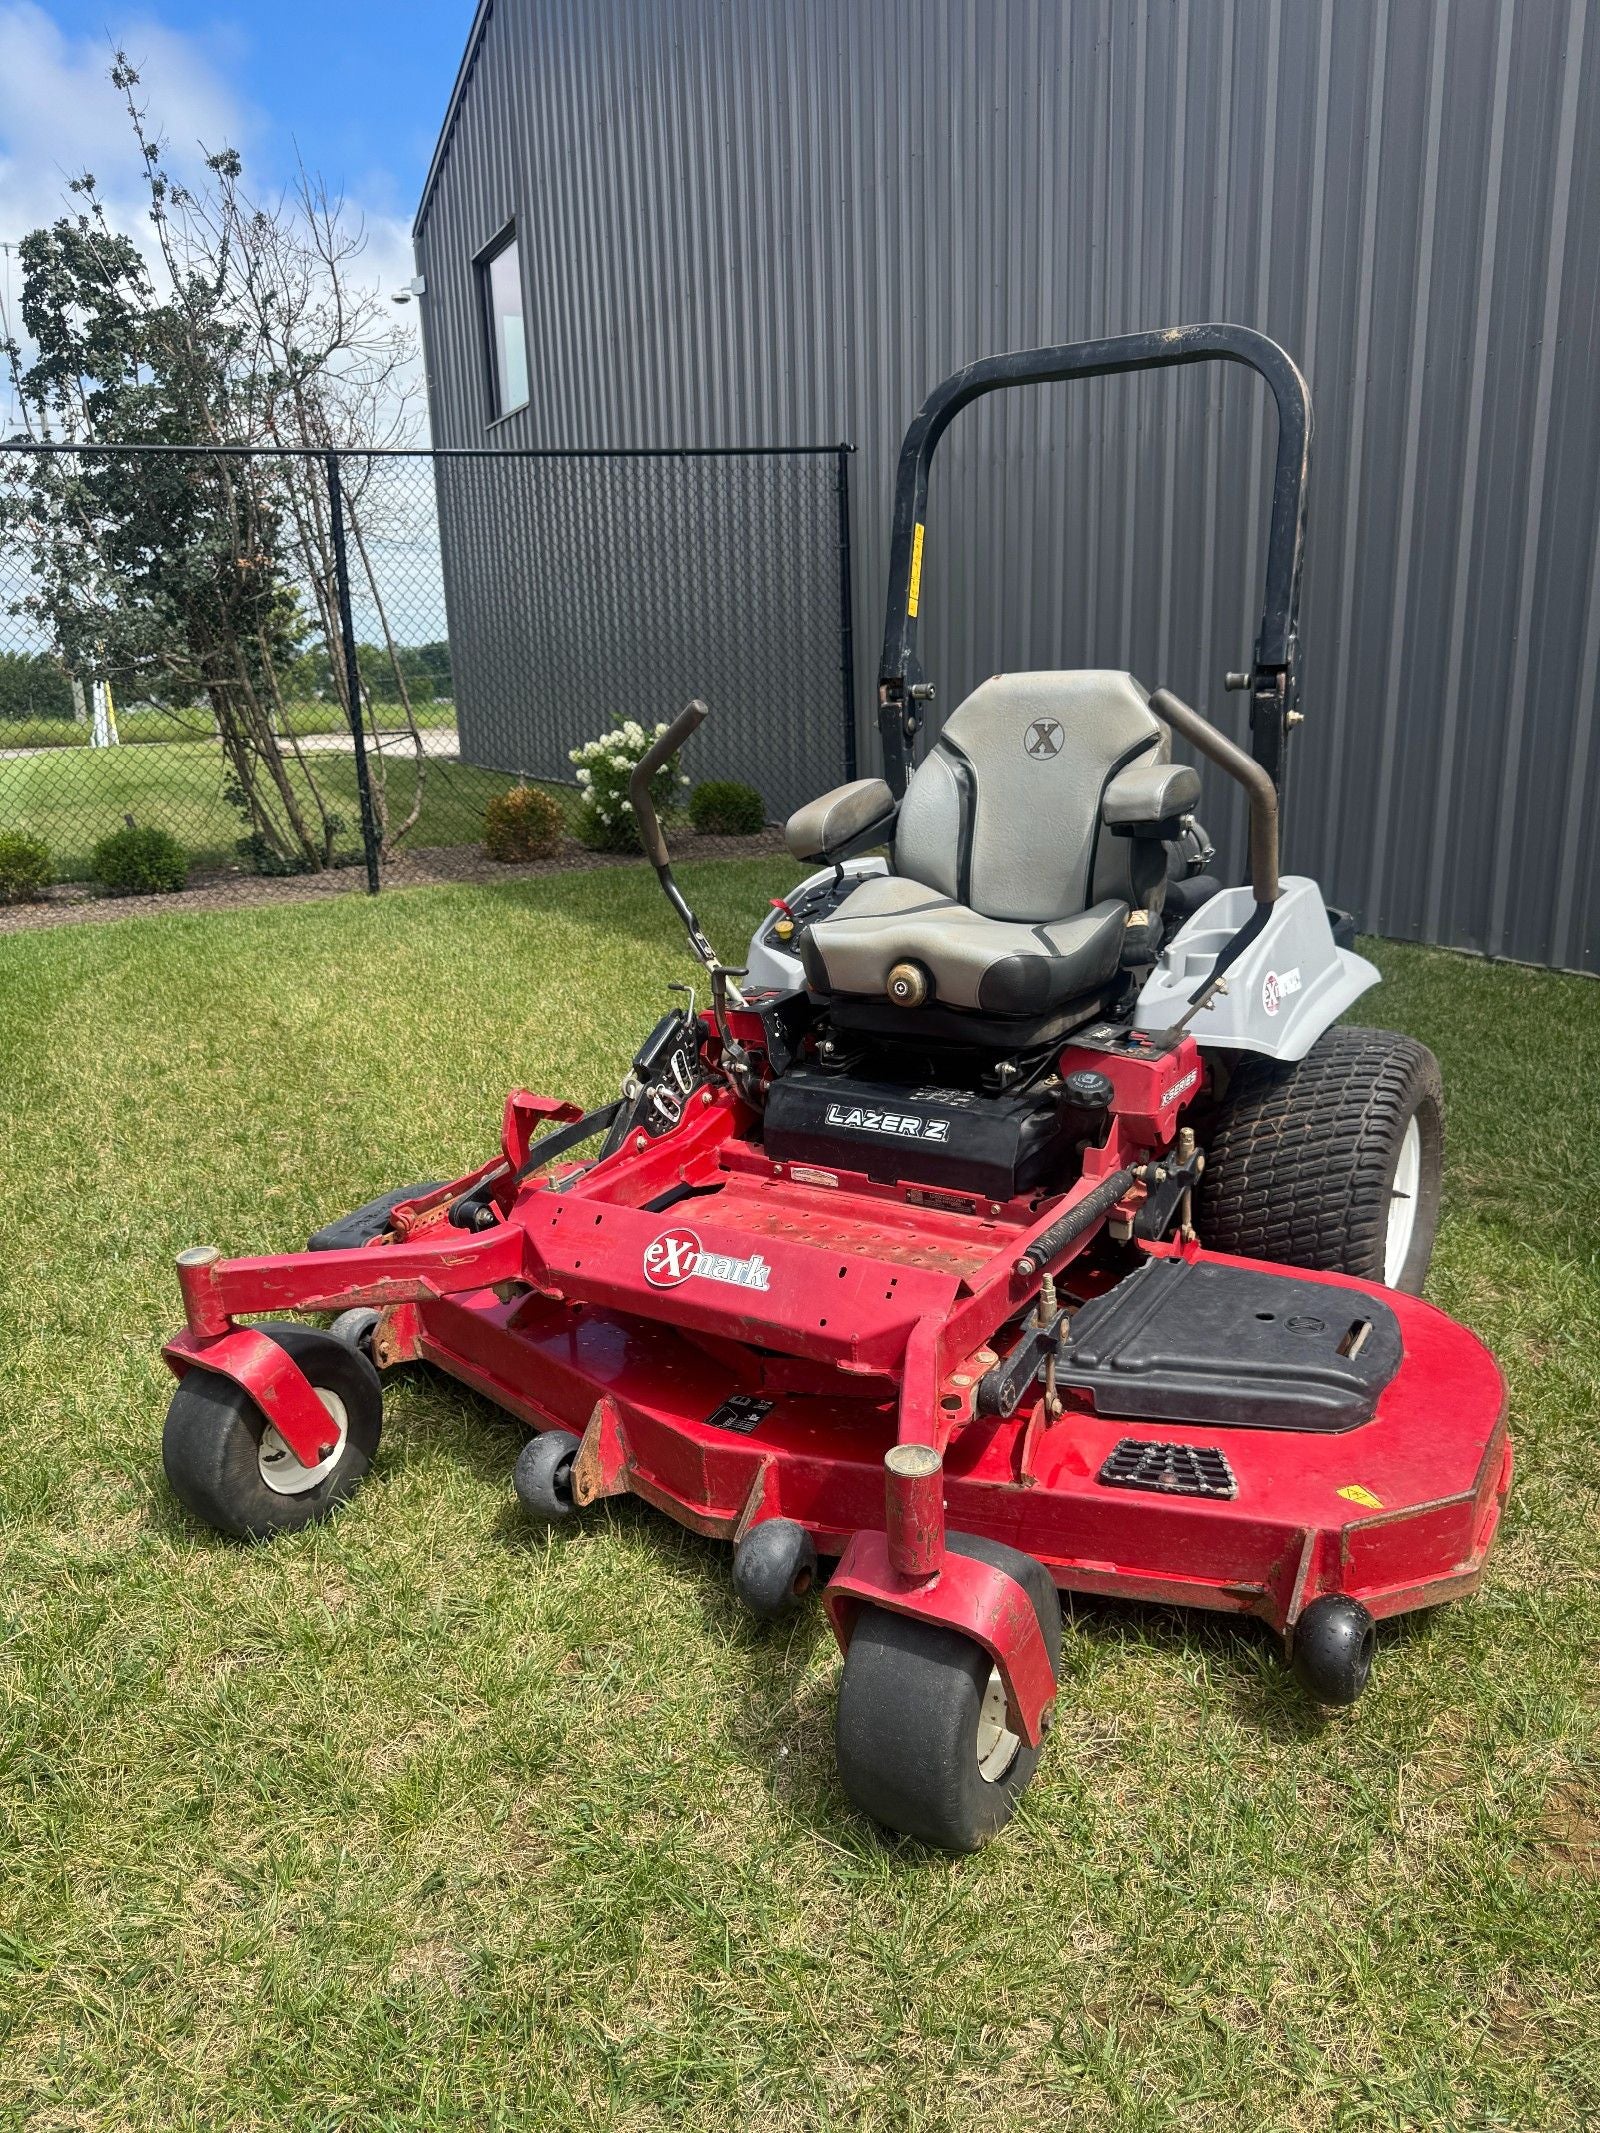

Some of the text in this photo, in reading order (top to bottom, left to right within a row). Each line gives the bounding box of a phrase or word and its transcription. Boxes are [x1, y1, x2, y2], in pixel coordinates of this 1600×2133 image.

[1029, 723, 1059, 754] X
[827, 1105, 949, 1140] LAZER Z
[645, 1234, 769, 1289] eXmark
